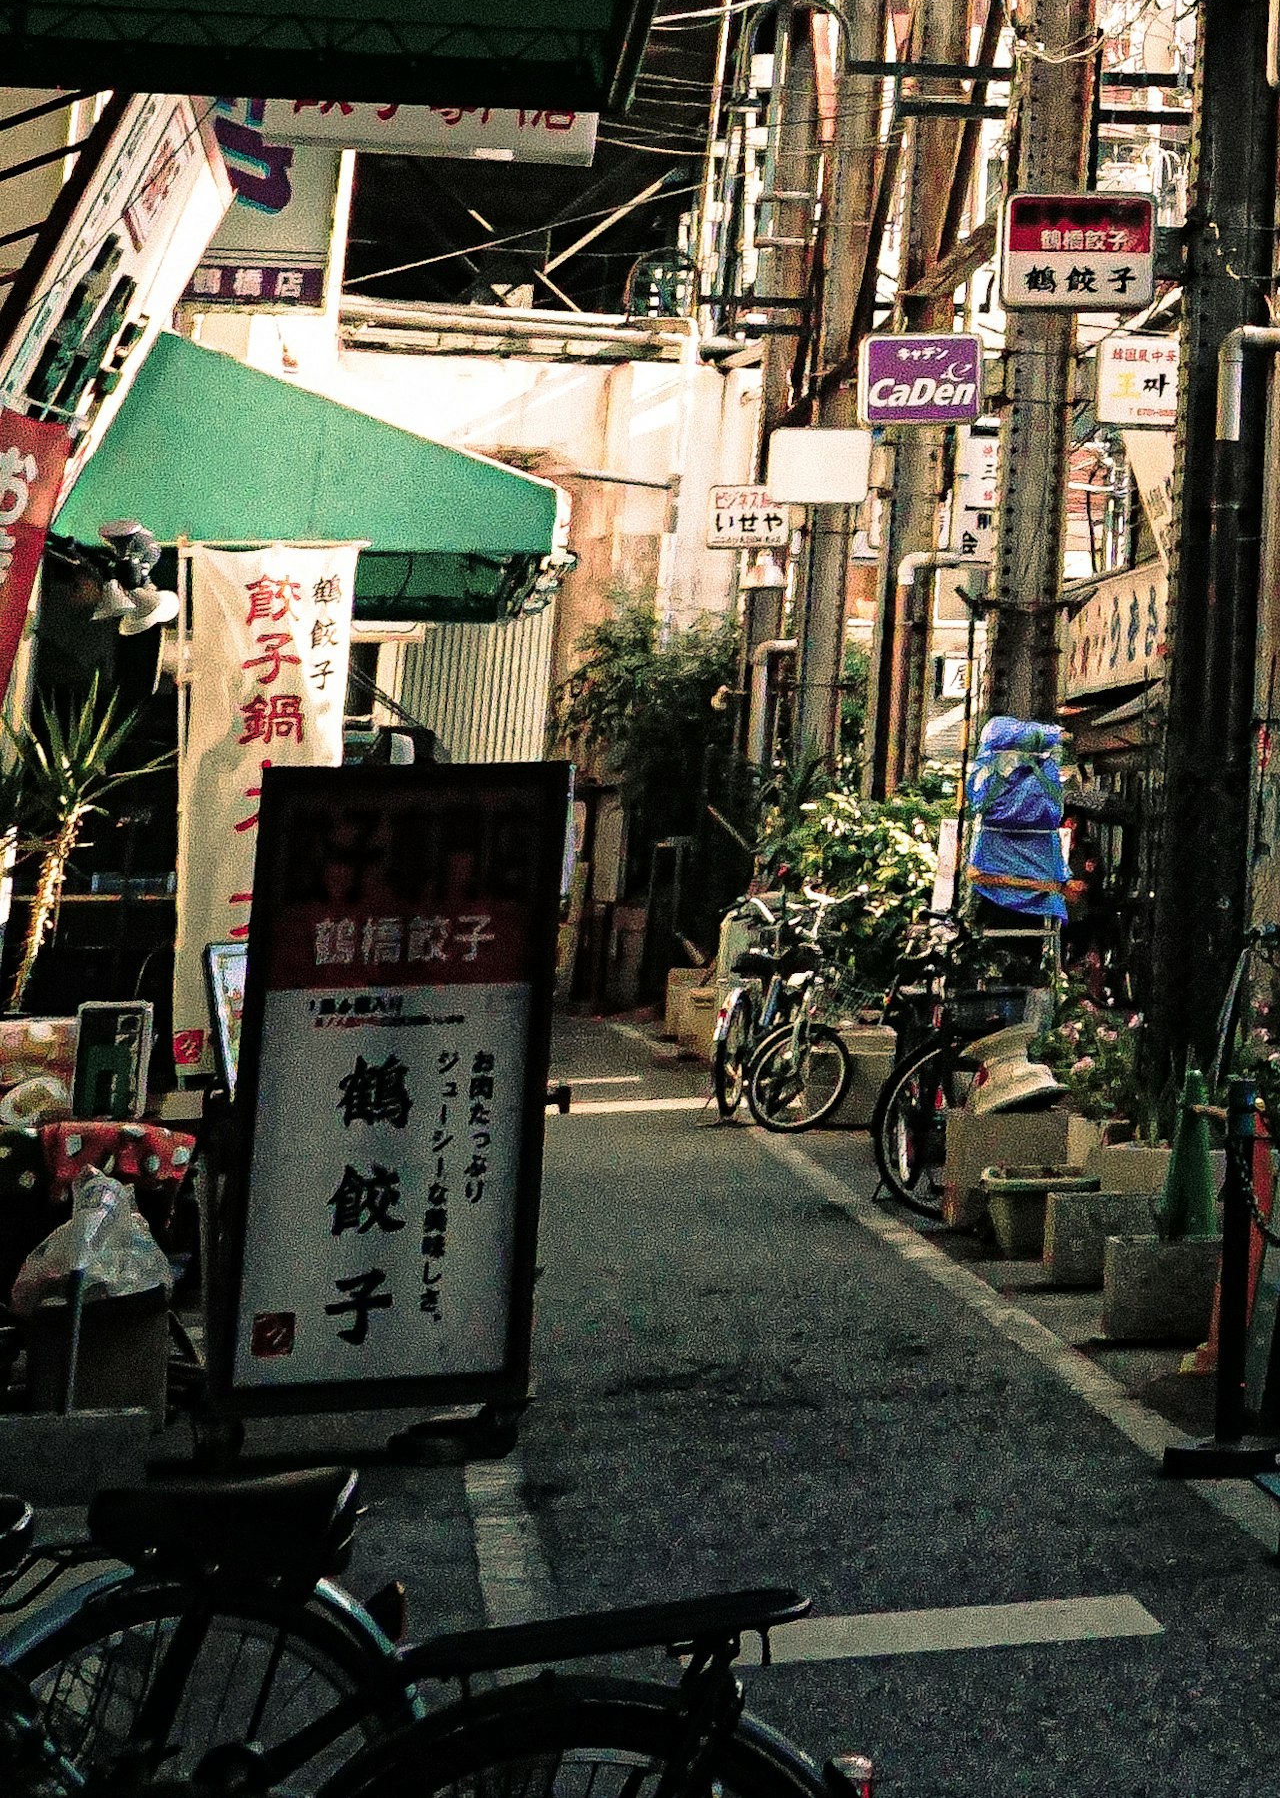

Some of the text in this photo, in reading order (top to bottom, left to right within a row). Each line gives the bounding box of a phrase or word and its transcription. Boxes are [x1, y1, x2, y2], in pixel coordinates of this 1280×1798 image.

[1025, 266, 1136, 293] 鶴餃子
[869, 377, 976, 407] CaDen
[716, 513, 783, 532] いせや
[239, 573, 305, 746] 餃子鍋
[310, 575, 342, 692] 鶴餃子
[314, 914, 495, 966] 鶴橋餃子
[324, 1055, 412, 1345] 鶴餃子
